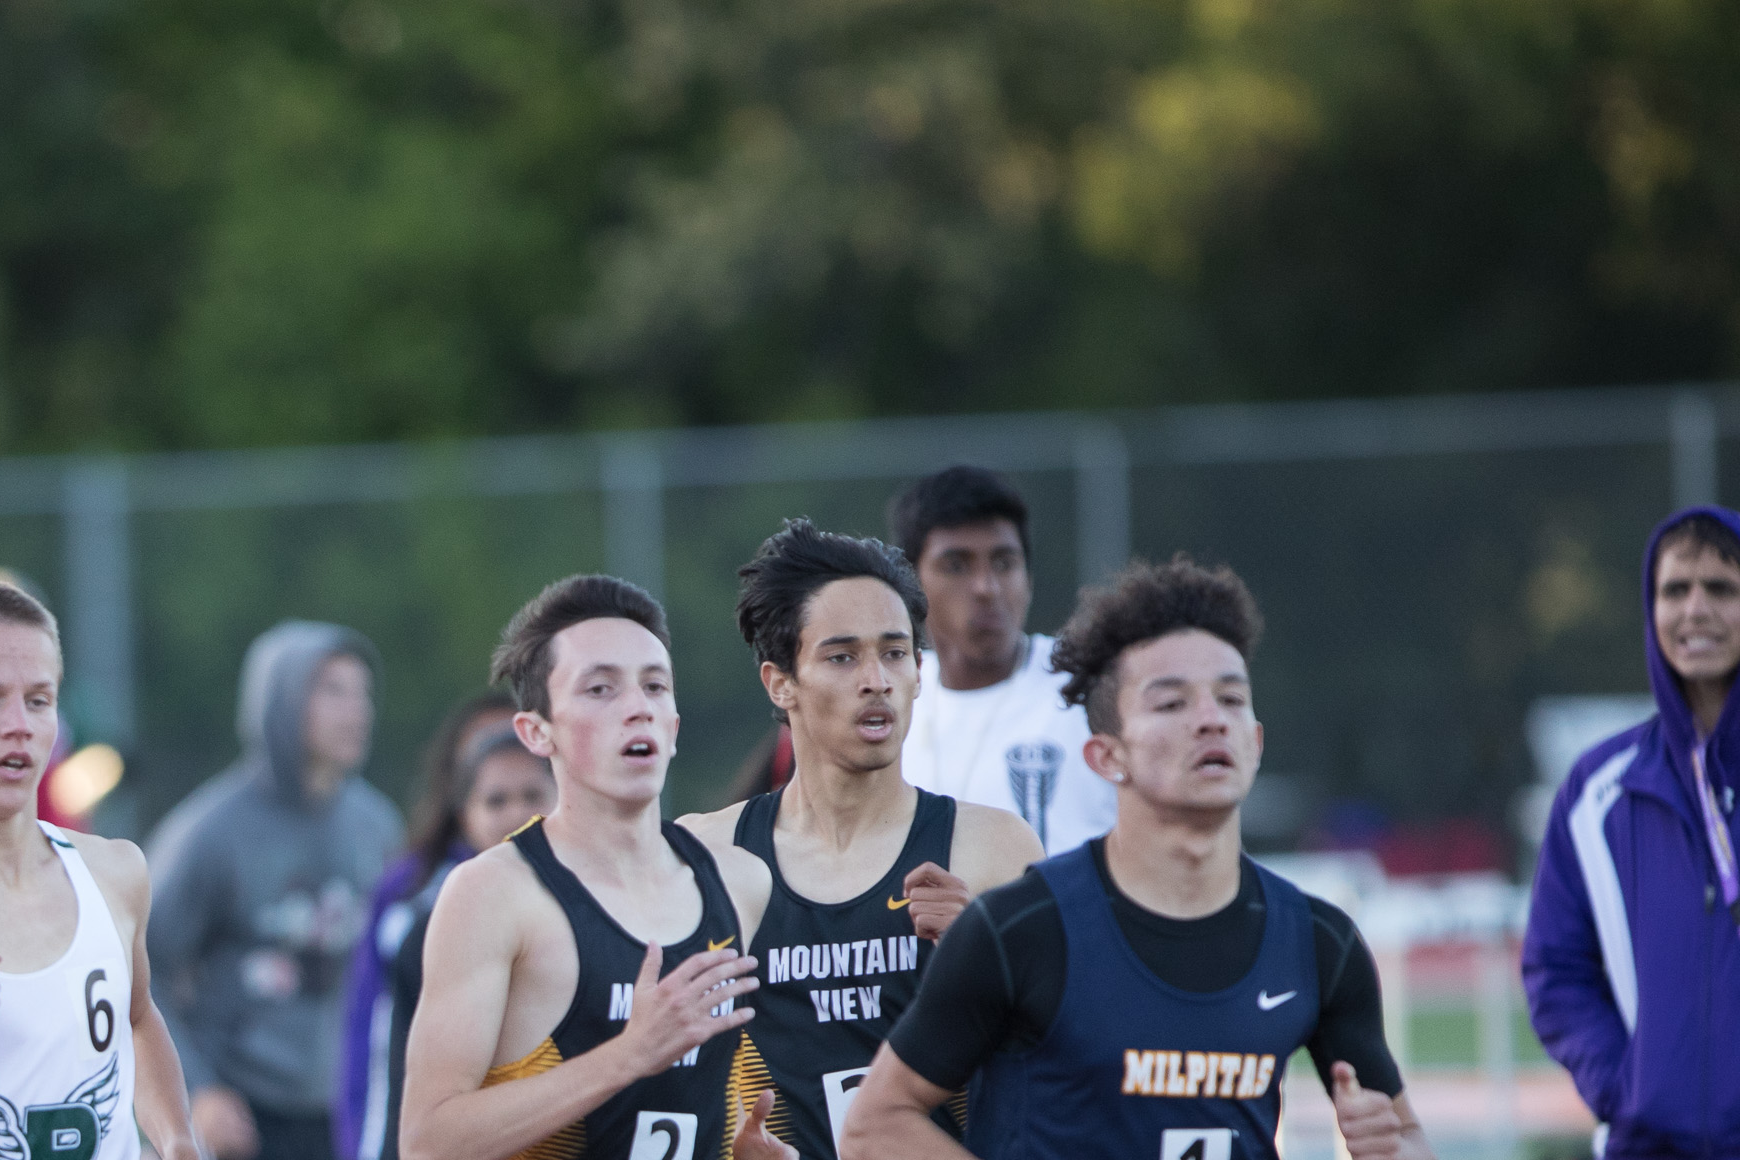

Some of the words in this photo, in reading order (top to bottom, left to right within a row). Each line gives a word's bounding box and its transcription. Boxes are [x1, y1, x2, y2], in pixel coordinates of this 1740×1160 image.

[768, 935, 918, 984] MOUNTAIN
[85, 968, 114, 1052] 6
[810, 985, 882, 1023] VIEW
[1122, 1049, 1276, 1099] MILPITAS
